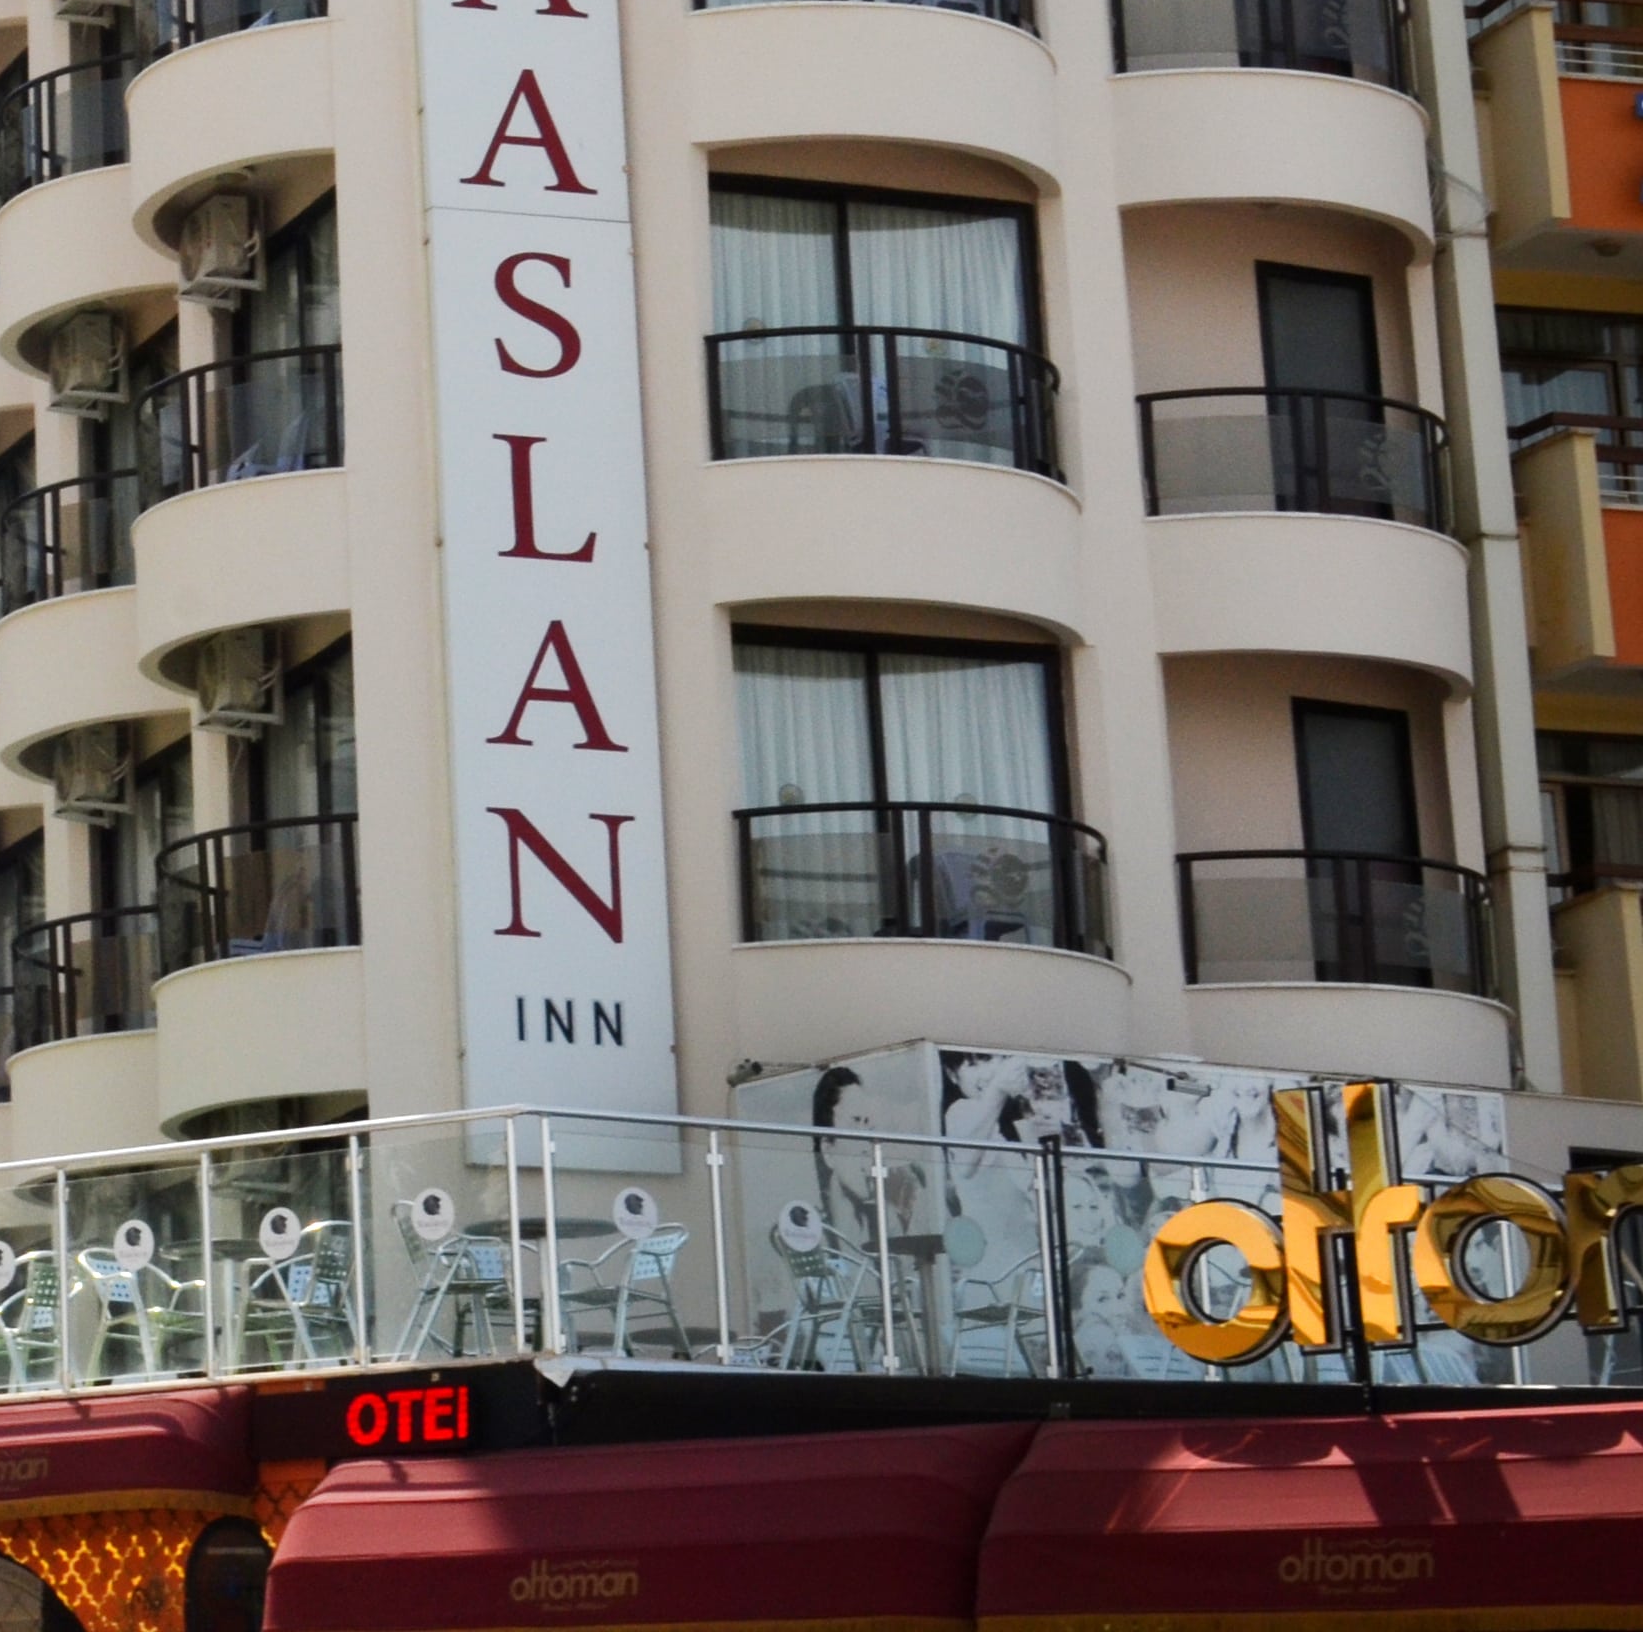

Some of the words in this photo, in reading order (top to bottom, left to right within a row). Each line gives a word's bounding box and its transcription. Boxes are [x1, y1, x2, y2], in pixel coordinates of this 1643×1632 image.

[516, 995, 624, 1047] INN
[510, 1559, 639, 1601] ottoman
[1278, 1537, 1436, 1583] ottoman
